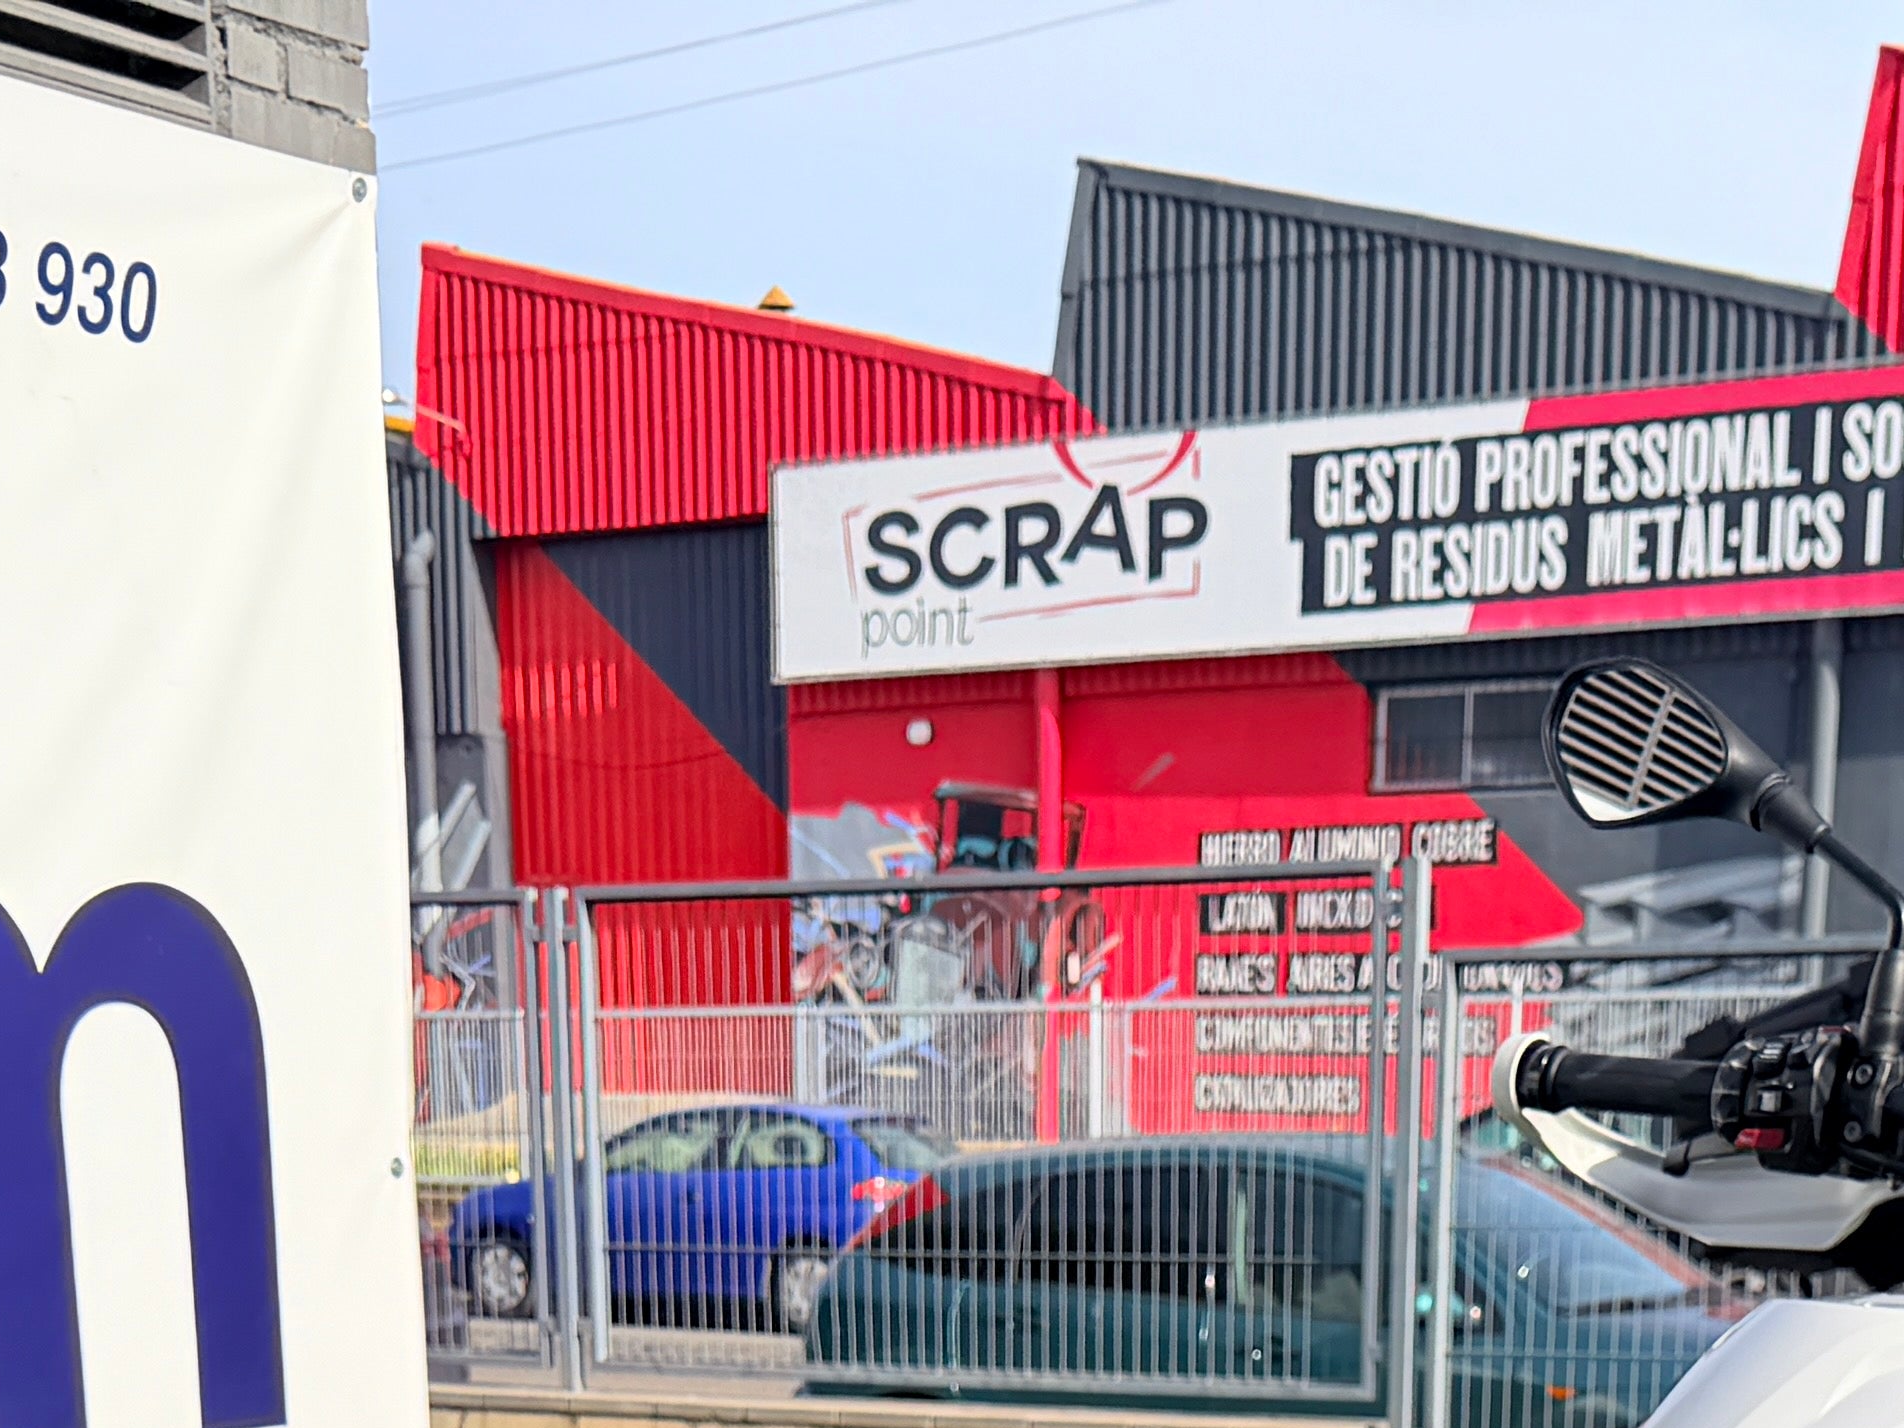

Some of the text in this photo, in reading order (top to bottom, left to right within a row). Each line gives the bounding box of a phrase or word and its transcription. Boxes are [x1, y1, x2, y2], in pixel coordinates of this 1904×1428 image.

[35, 241, 158, 343] 930
[1314, 441, 1461, 528] GESTIÓ
[1474, 411, 1802, 513] PROFESSIONAL
[864, 484, 1210, 596] SCRAP
[1323, 532, 1379, 608] DE
[1390, 513, 1569, 602] RESIDUS
[860, 598, 974, 658] point
